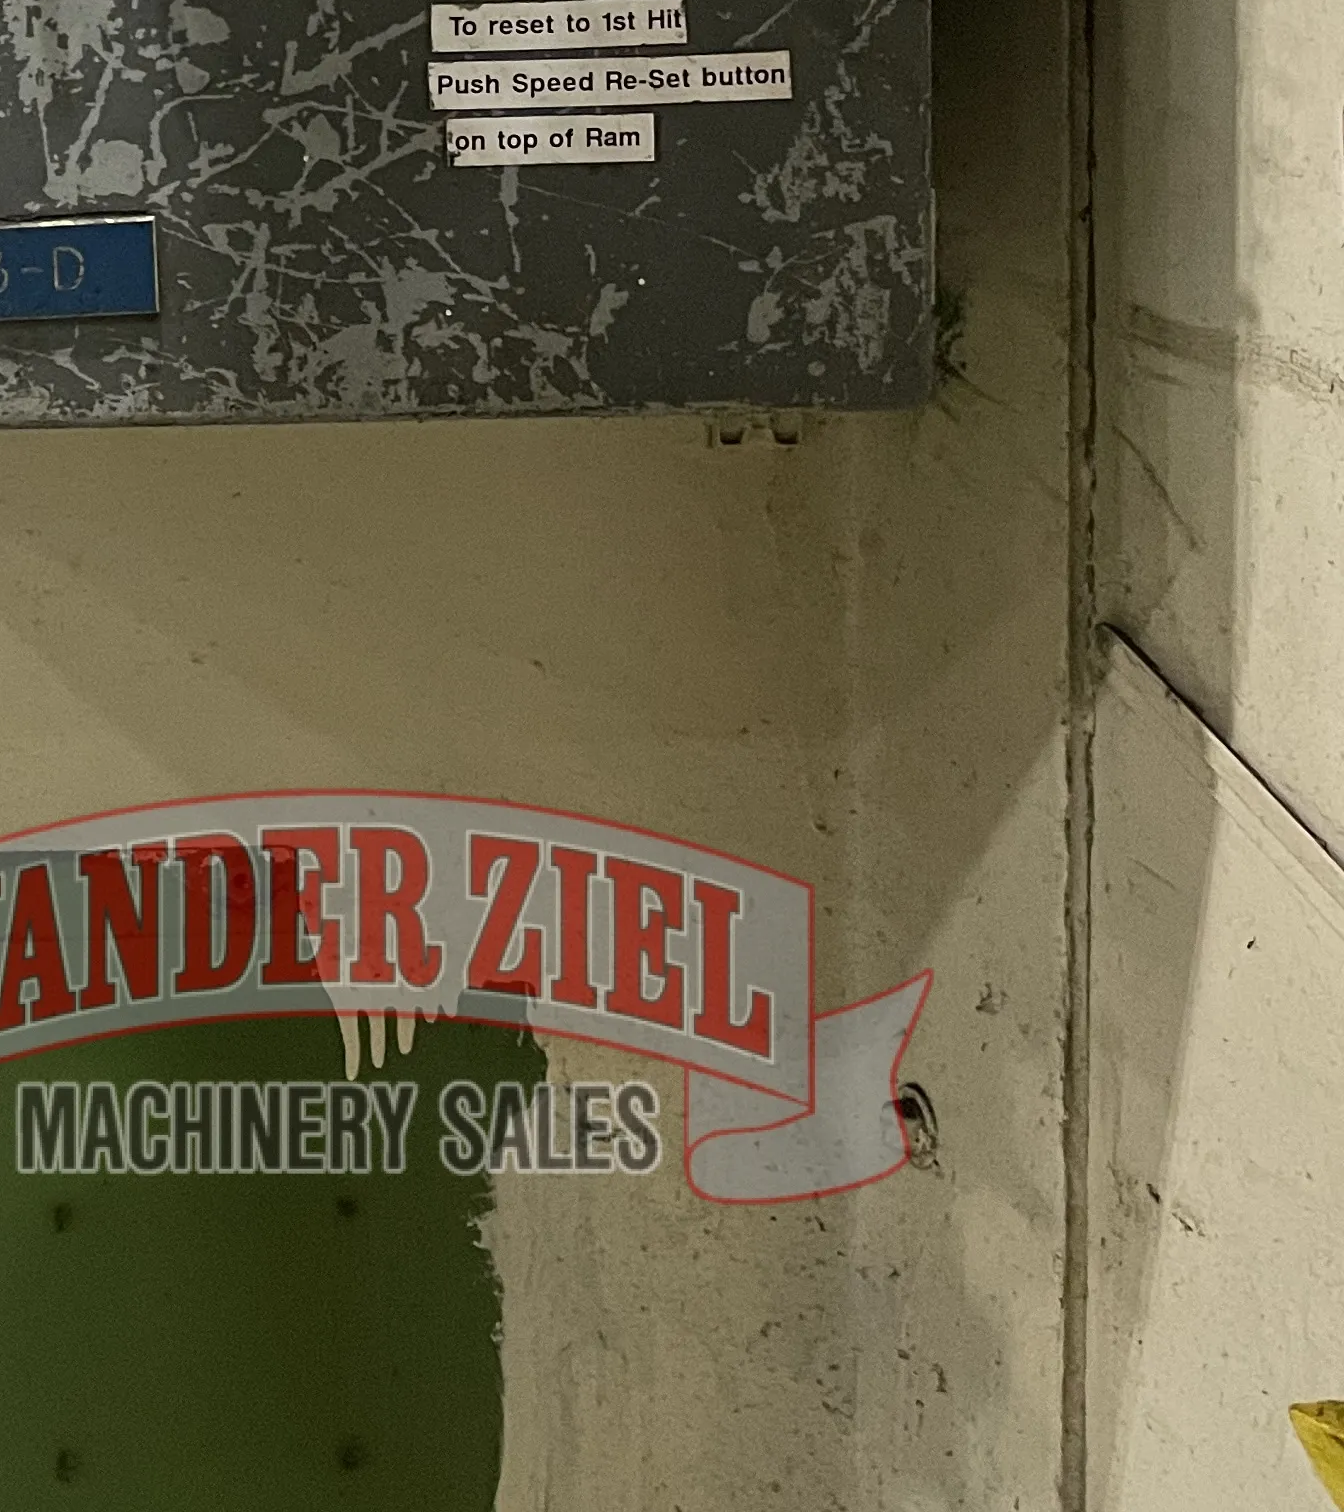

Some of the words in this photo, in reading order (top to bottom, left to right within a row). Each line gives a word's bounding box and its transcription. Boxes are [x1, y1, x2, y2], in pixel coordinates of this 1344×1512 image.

[449, 16, 477, 37] To
[488, 14, 554, 36] reset
[566, 13, 591, 33] to
[601, 12, 636, 32] 1st
[648, 9, 682, 30] Hit
[437, 73, 500, 95] Push
[512, 72, 594, 98] Speed
[605, 69, 690, 92] Re-Set
[702, 67, 785, 86] button
[454, 134, 486, 151] on
[498, 130, 539, 154] top
[549, 128, 574, 149] of
[585, 127, 640, 147] Ram
